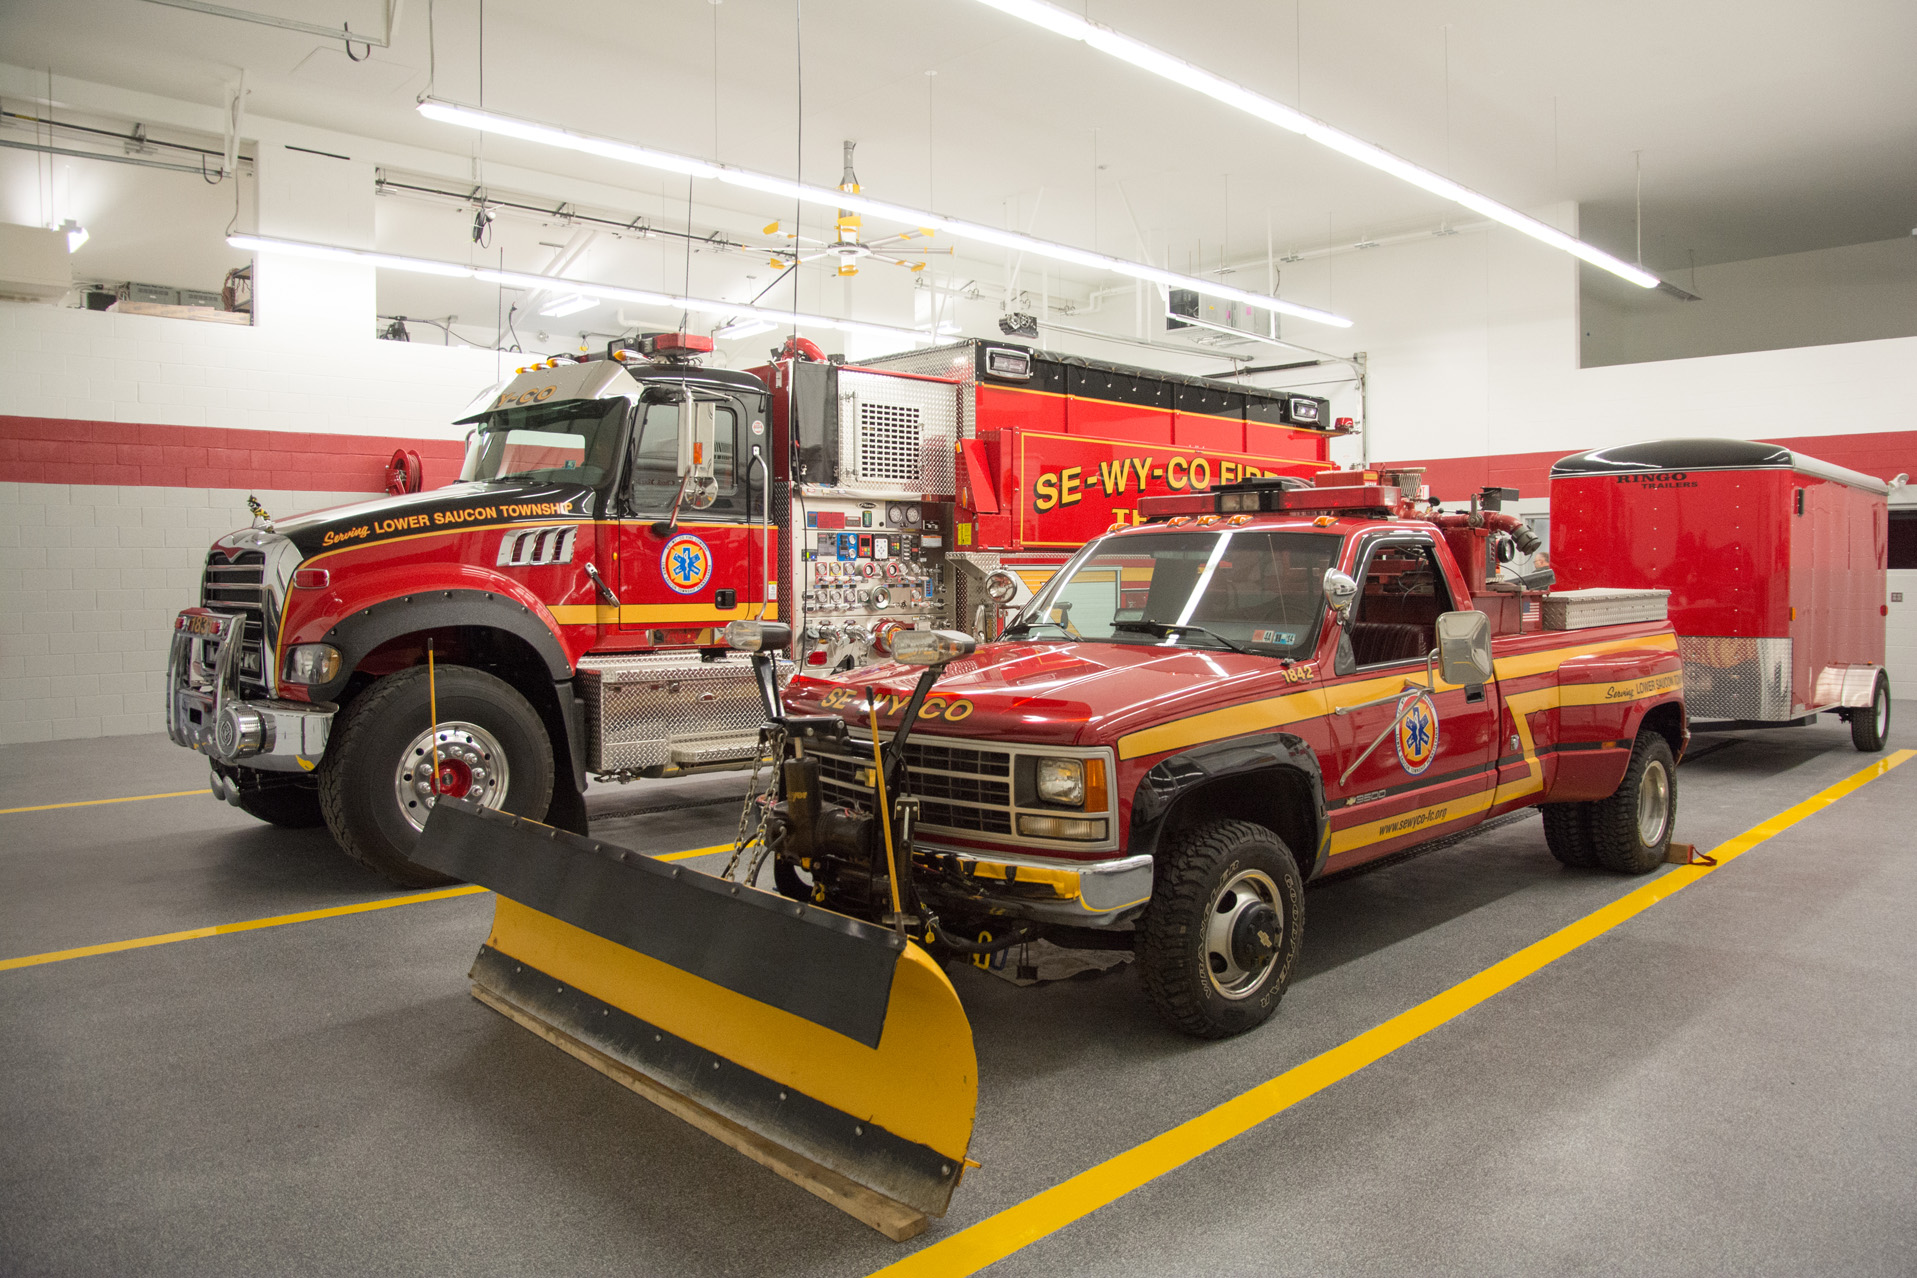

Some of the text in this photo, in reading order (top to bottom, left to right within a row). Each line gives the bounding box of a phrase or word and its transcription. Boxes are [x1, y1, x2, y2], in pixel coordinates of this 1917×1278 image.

[1033, 456, 1279, 514] SE-WY-CO FI
[1617, 473, 1687, 483] RINGO
[322, 502, 573, 546] Serving LOWER SAUCON TOWNSHIP
[1281, 665, 1314, 684] 1842
[1604, 685, 1635, 699] Serving
[1636, 679, 1655, 694] LOWER
[820, 686, 975, 723] SE-WYCO
[1379, 808, 1448, 837] www.sewyco-fc.org
[1260, 873, 1299, 1009] GOODYEAR
